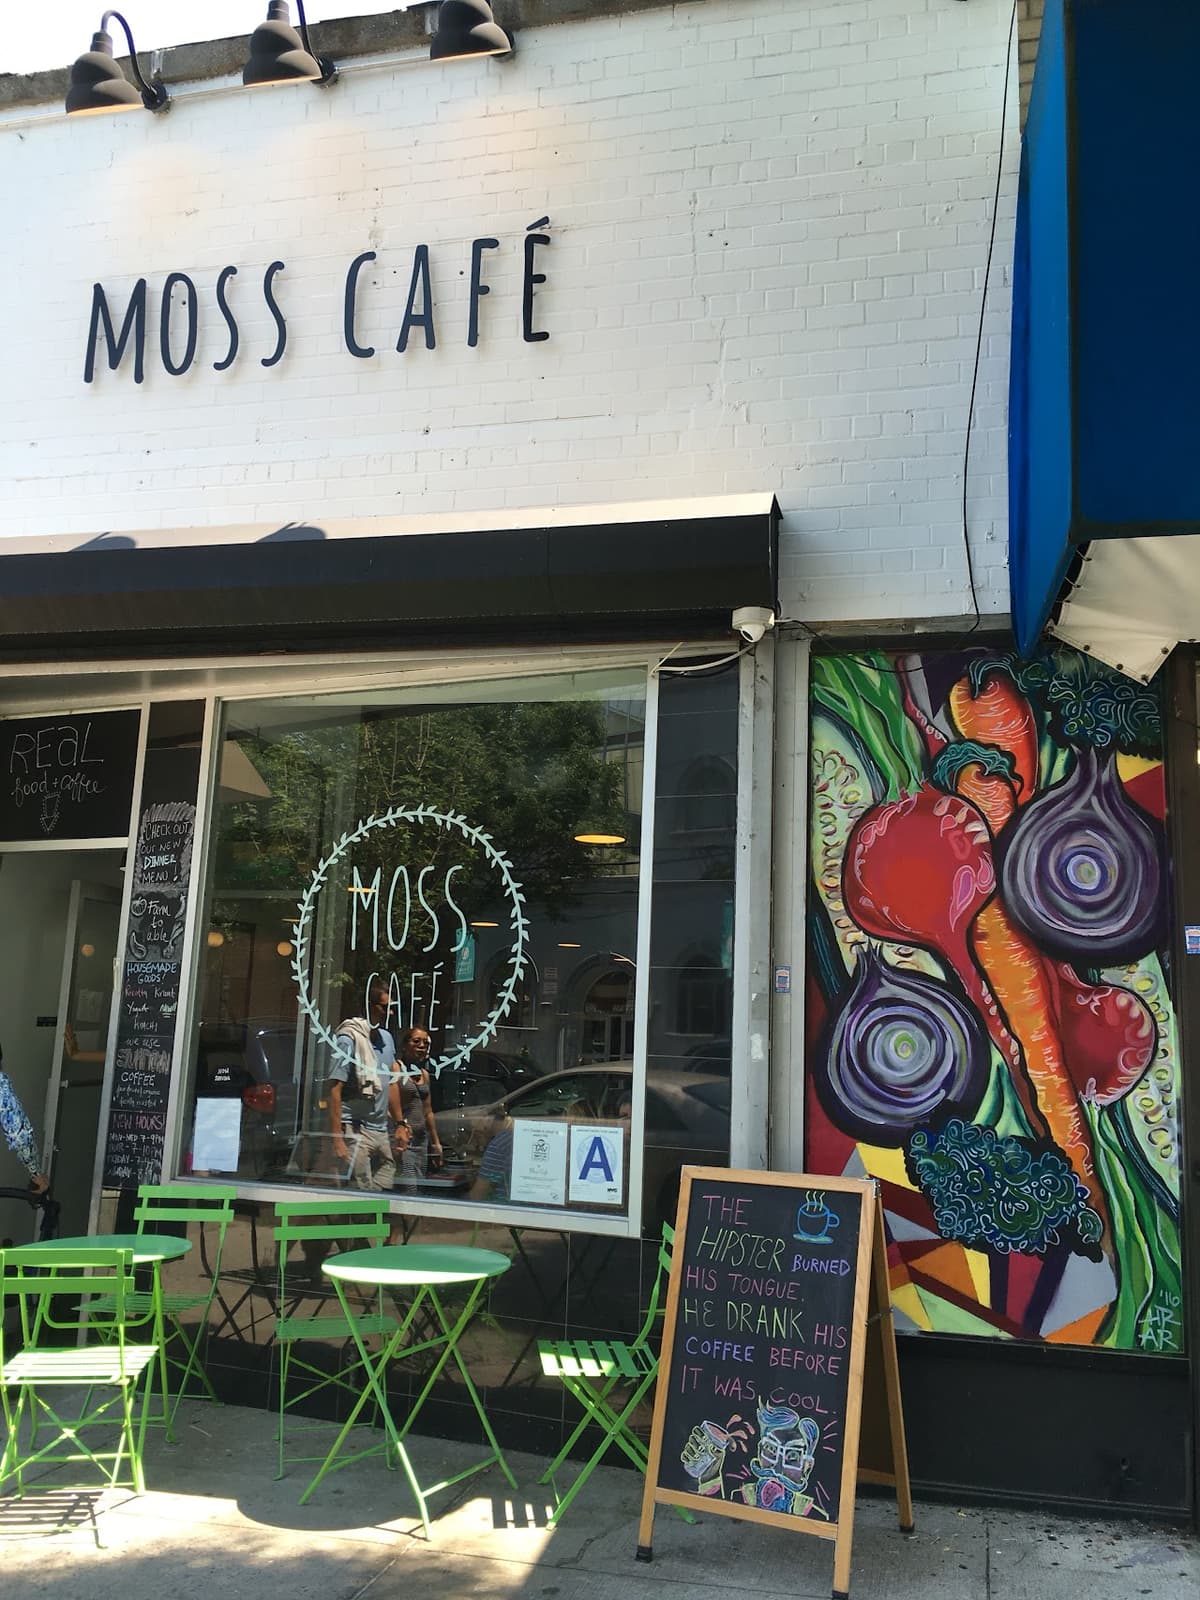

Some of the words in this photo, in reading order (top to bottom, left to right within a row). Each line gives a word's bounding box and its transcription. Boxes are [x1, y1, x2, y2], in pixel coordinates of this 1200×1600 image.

[84, 261, 287, 385] MOSS
[344, 216, 551, 358] CAFÉ
[11, 770, 49, 807] food
[145, 822, 172, 841] CHECK
[173, 821, 190, 835] OUT
[159, 837, 182, 852] NEW
[143, 854, 177, 870] DINNER
[147, 900, 172, 917] Farm
[150, 916, 164, 929] to
[351, 865, 468, 952] MOSS
[127, 961, 177, 976] HOUSEMADE
[365, 961, 444, 1032] CAFÉ
[121, 1071, 156, 1086] COFFEE
[578, 1136, 614, 1182] A
[702, 1195, 752, 1225] THE
[696, 1226, 786, 1272] HIPSTER
[792, 1254, 850, 1277] BURNED
[686, 1265, 717, 1291] HIS
[684, 1298, 716, 1329] HE
[727, 1301, 806, 1343] DRANK
[814, 1323, 848, 1349] HIS
[685, 1336, 755, 1362] COFFEE
[769, 1347, 841, 1376] BEFORE
[681, 1364, 704, 1393] IT
[714, 1375, 756, 1401] WAS
